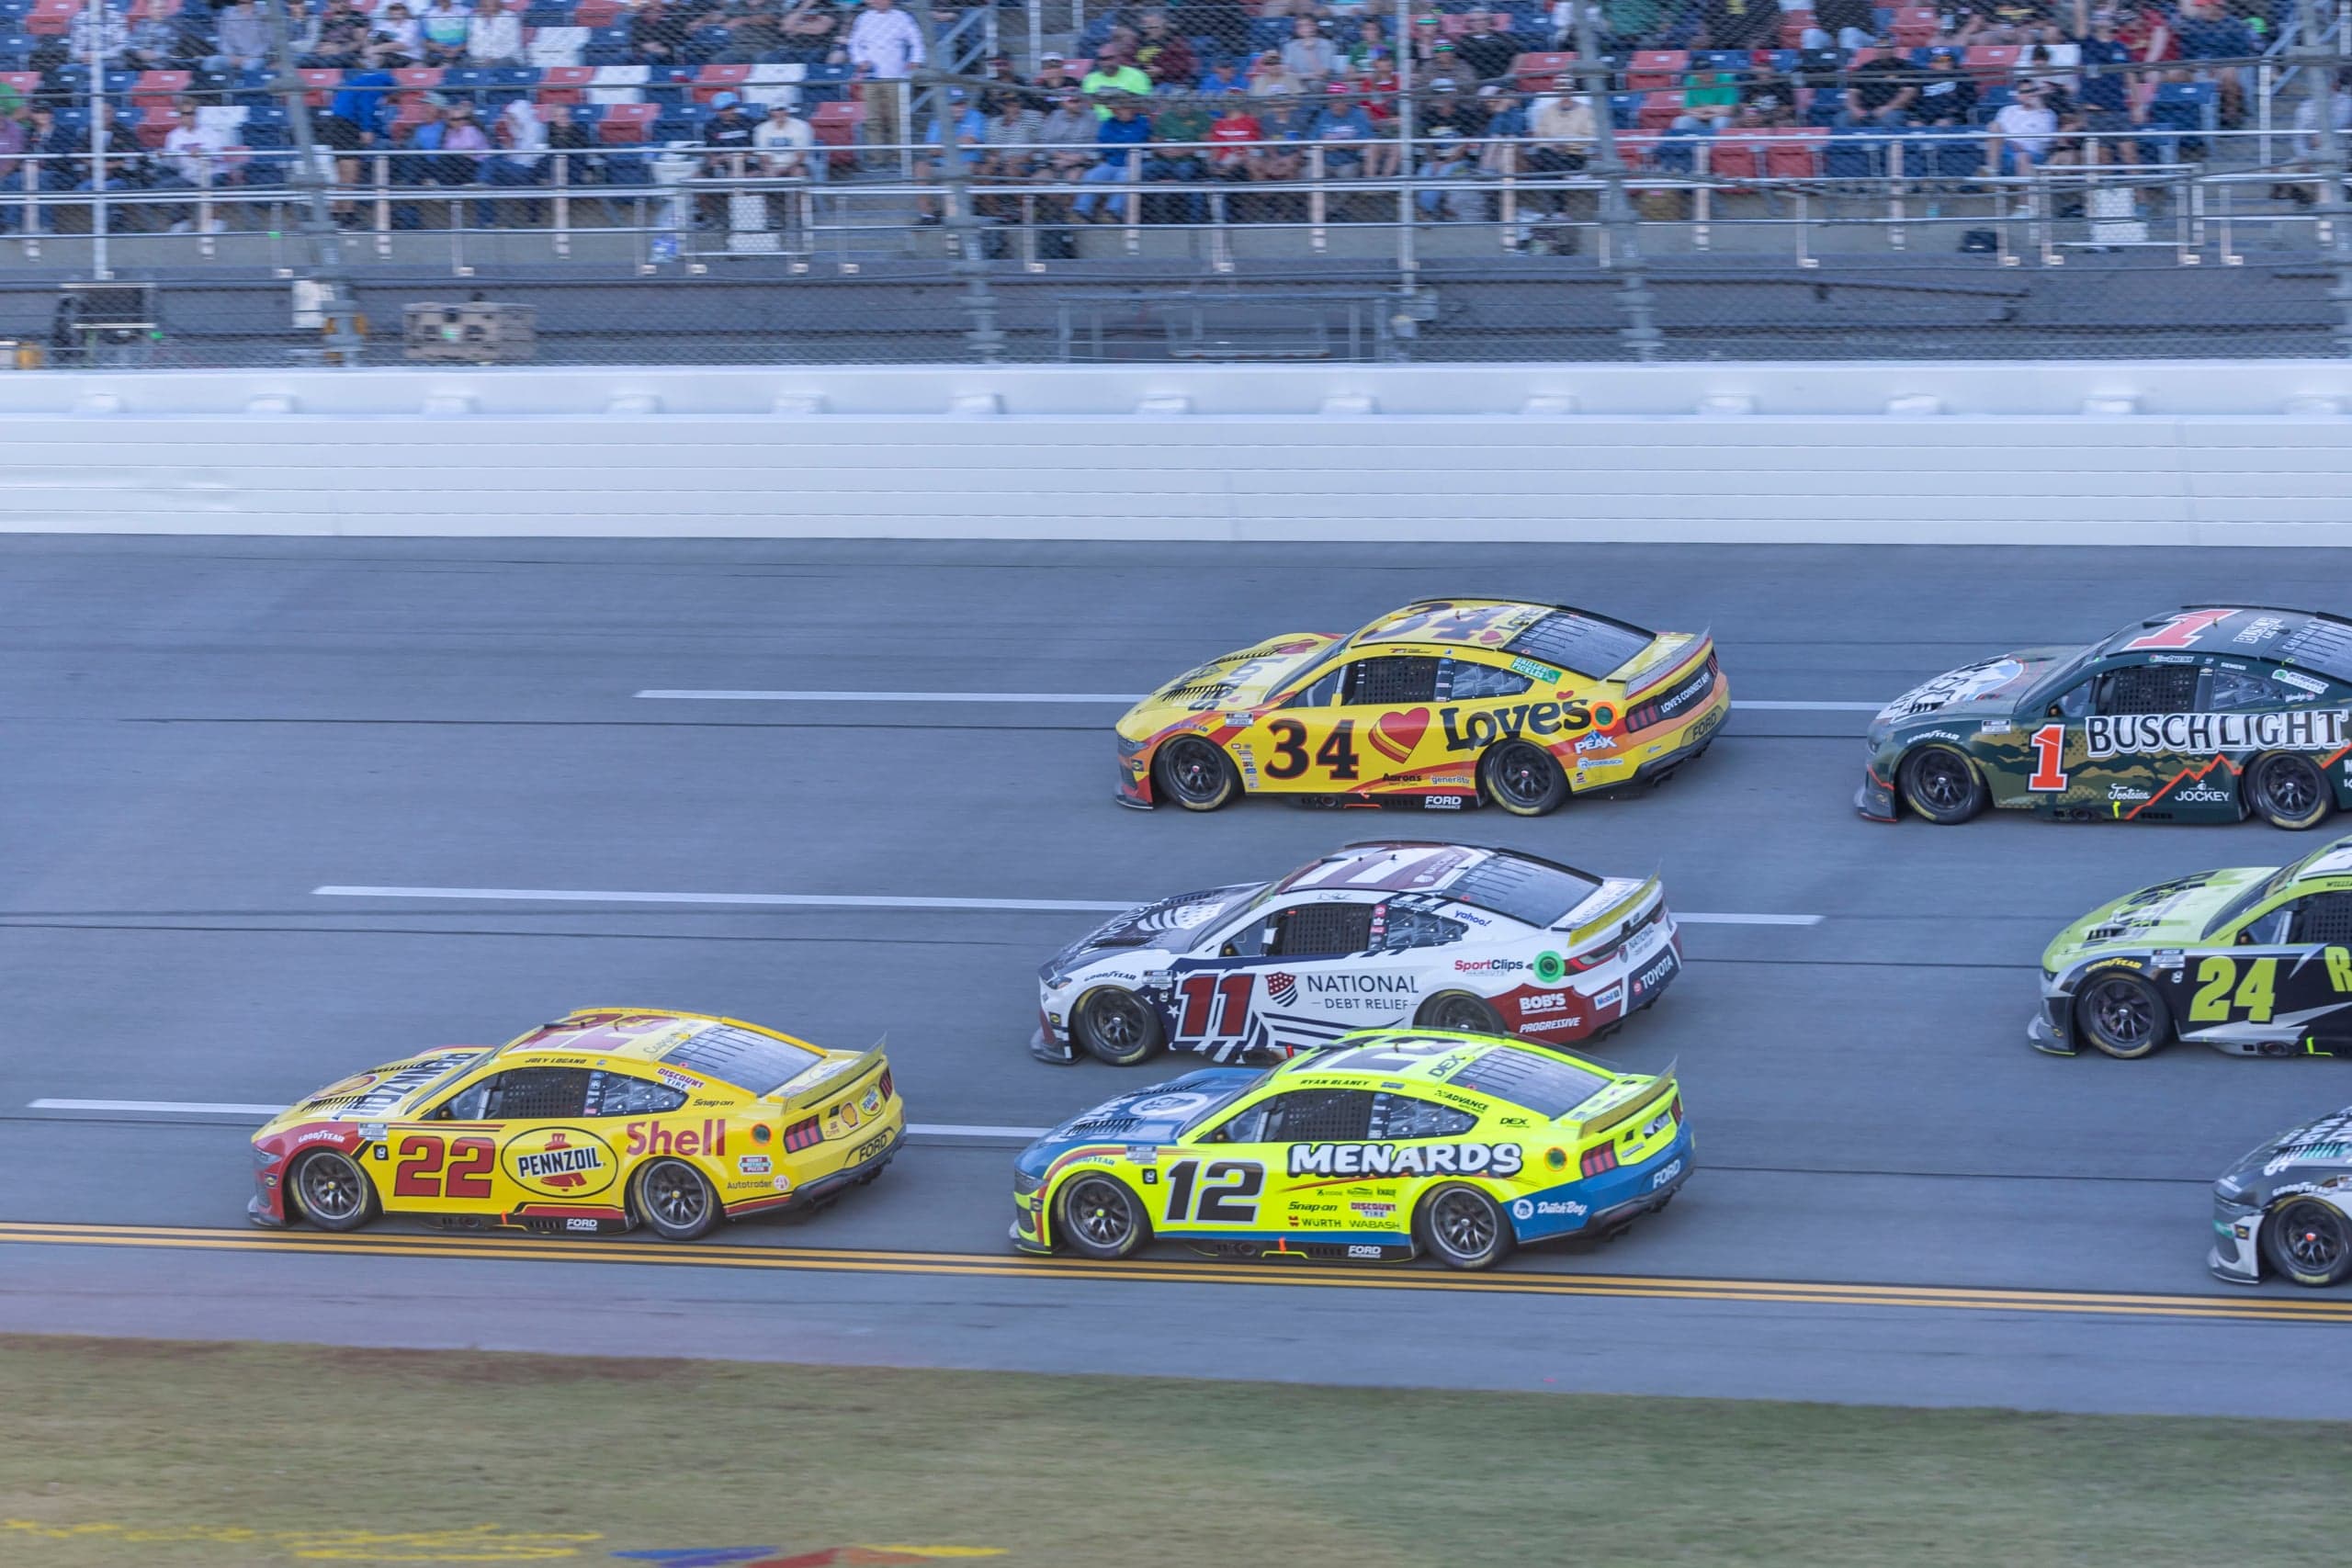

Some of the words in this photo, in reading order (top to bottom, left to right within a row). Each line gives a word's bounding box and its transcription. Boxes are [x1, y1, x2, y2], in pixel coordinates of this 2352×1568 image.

[2122, 609, 2244, 651] 1
[1692, 713, 1717, 739] FORD
[1264, 718, 1360, 781] 34
[1574, 737, 1617, 754] PEAK
[2028, 723, 2068, 792] 1
[1426, 795, 1462, 805] FORD
[2175, 791, 2230, 802] JOCKEY
[1454, 910, 1493, 927] yahoo!
[1640, 955, 1674, 989] TOYOTA
[1307, 974, 1419, 994] NATIONAL
[2188, 955, 2278, 1023] 24
[1177, 970, 1256, 1040] 11
[1325, 998, 1362, 1010] DEBT
[1365, 998, 1408, 1010] RELIEF
[1519, 993, 1566, 1010] BOB'S
[1519, 1017, 1583, 1033] PROGRESSIVE
[1428, 1055, 1462, 1077] DEX
[658, 1067, 705, 1089] DISCOUNT
[666, 1077, 687, 1089] TIRE
[1445, 1093, 1489, 1111] ADVANCE
[1500, 1117, 1529, 1125] DEX
[626, 1119, 726, 1156] Shell
[858, 1134, 888, 1161] FORD
[394, 1135, 496, 1199] 22
[517, 1146, 602, 1177] PENNZOIL
[1287, 1143, 1523, 1179] MENARDS
[727, 1180, 772, 1190] Autotrader
[1653, 1158, 1681, 1190] FORD
[1162, 1157, 1267, 1226] 12
[566, 1218, 597, 1227] FORD
[1349, 1220, 1401, 1229] WABASH
[1349, 1245, 1382, 1255] FORD
